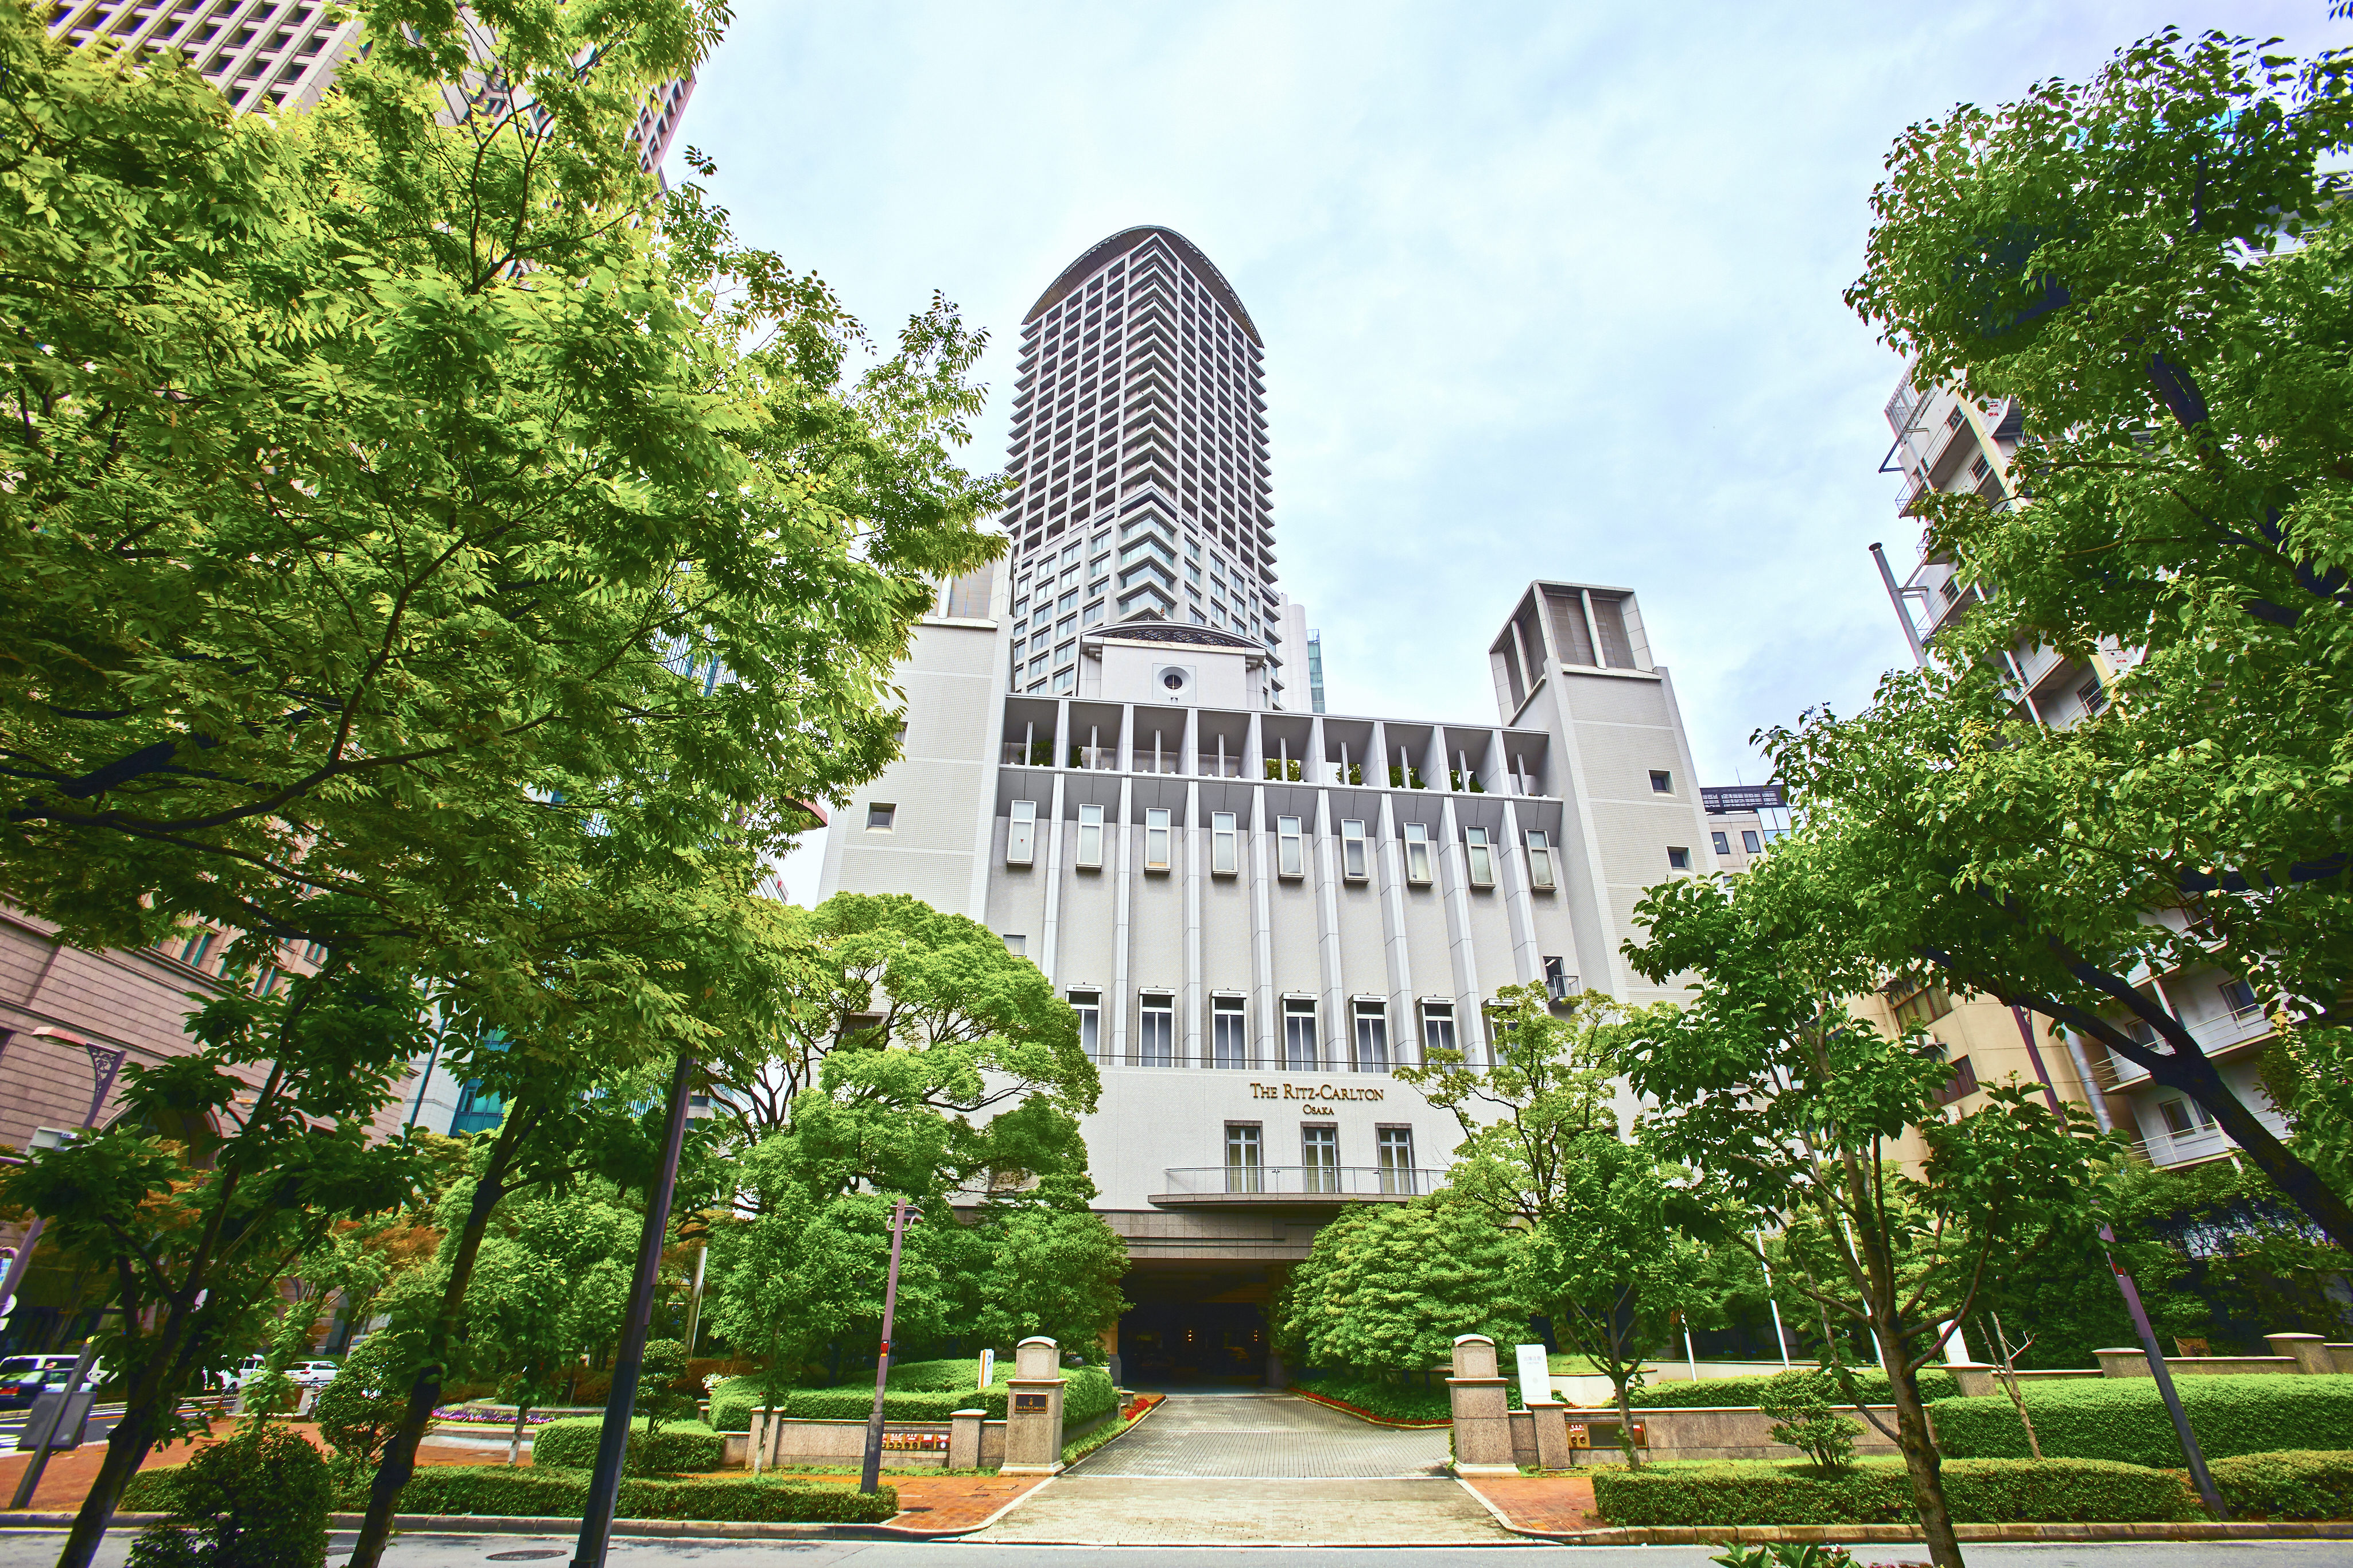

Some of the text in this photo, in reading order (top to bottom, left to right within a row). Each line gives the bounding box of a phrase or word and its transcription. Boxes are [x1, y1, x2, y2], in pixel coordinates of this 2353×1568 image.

[1250, 1083, 1384, 1100] THE RITZ-CARLTON
[1303, 1104, 1334, 1115] OSAKA
